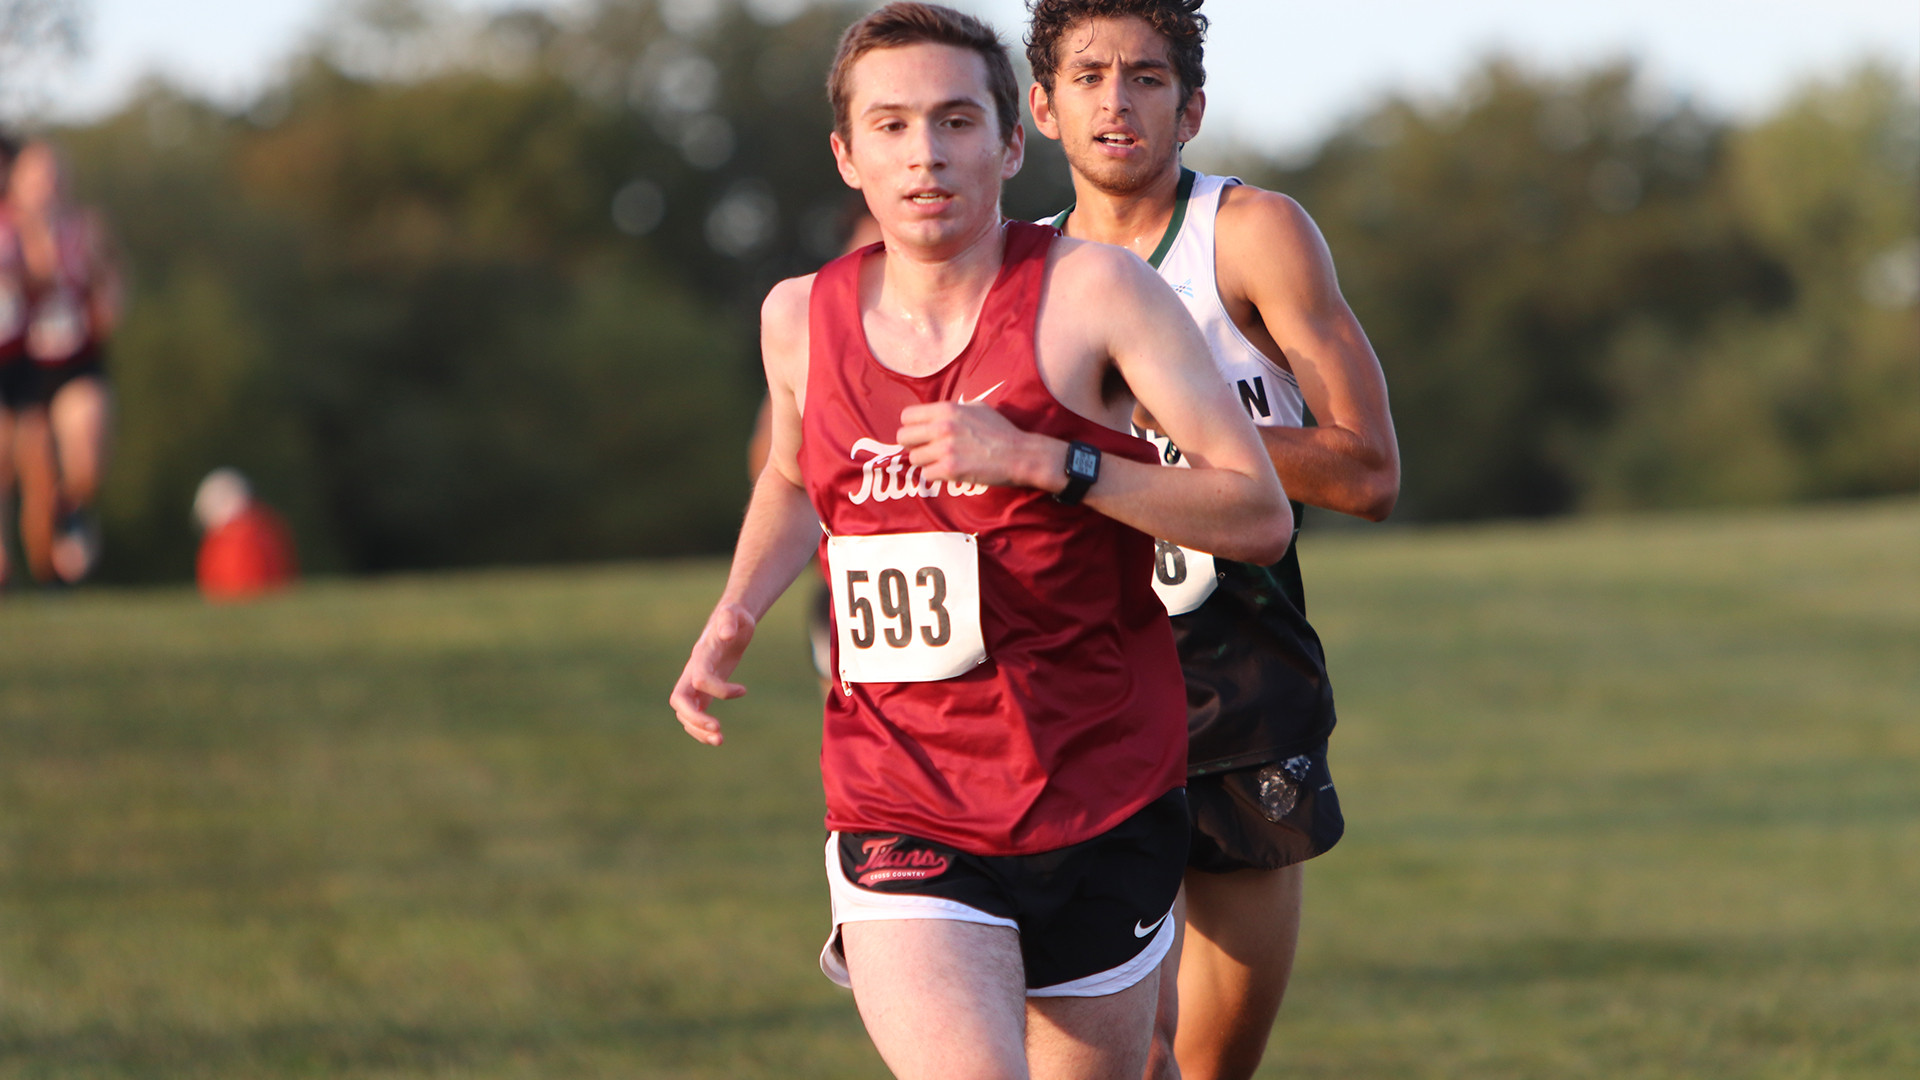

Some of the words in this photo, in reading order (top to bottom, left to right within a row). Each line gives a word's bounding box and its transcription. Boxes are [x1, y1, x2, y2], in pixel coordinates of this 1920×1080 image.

[1227, 376, 1271, 420] N
[846, 566, 951, 649] 593
[855, 836, 942, 872] Titans
[870, 872, 890, 880] CROSS
